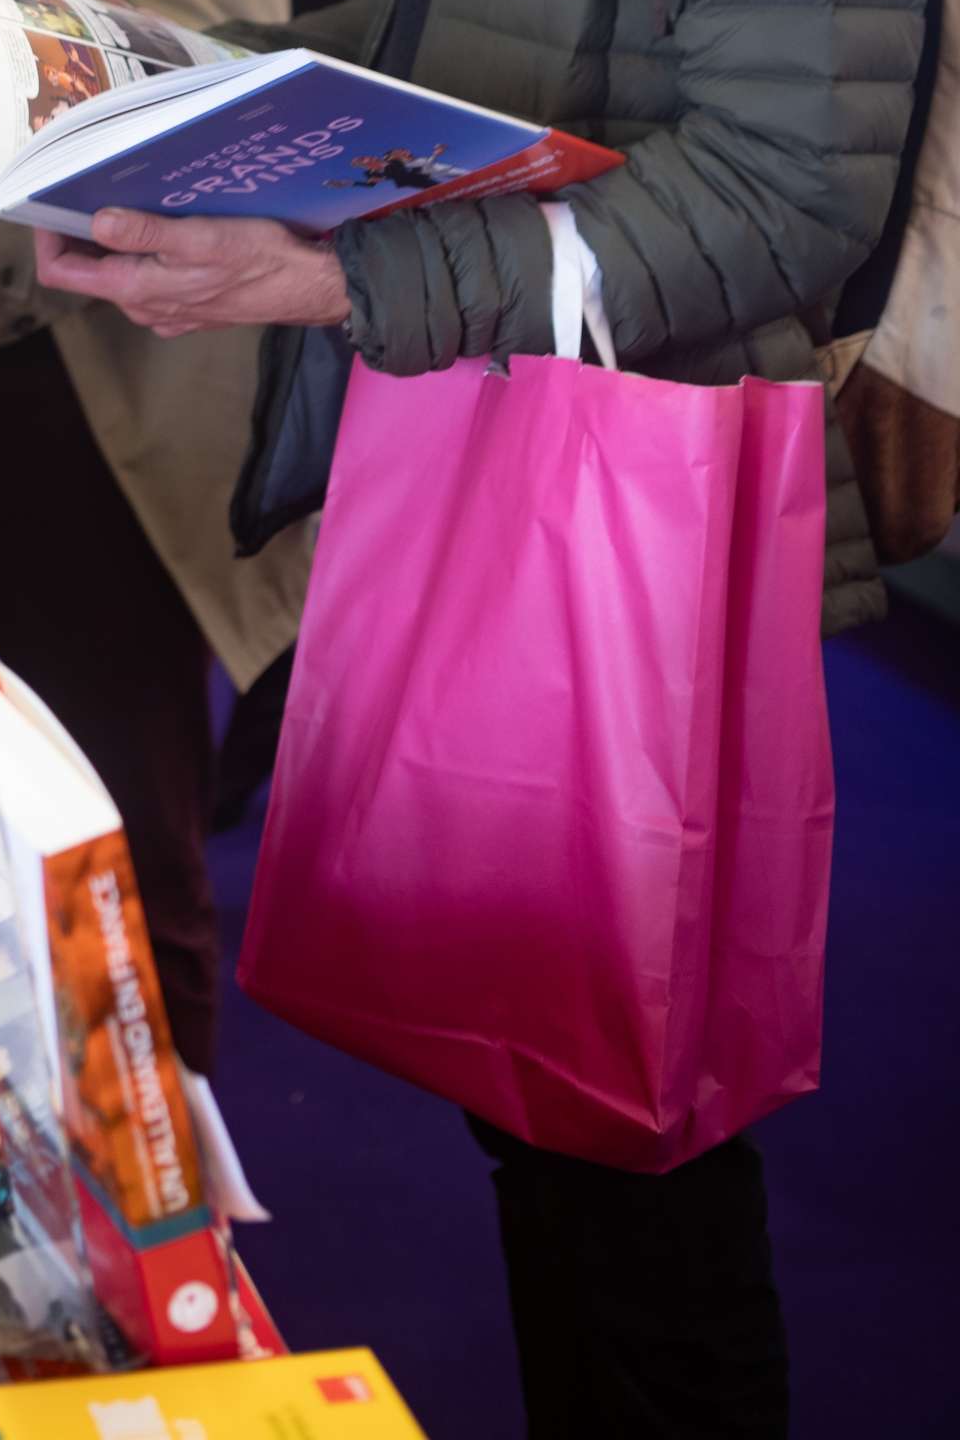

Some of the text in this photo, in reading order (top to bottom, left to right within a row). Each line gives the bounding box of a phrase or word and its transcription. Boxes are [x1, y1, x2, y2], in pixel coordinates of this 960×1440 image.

[161, 123, 289, 182] HISTOIRE
[161, 116, 365, 208] GRANDS
[213, 144, 266, 170] DES
[221, 143, 345, 194] VINS
